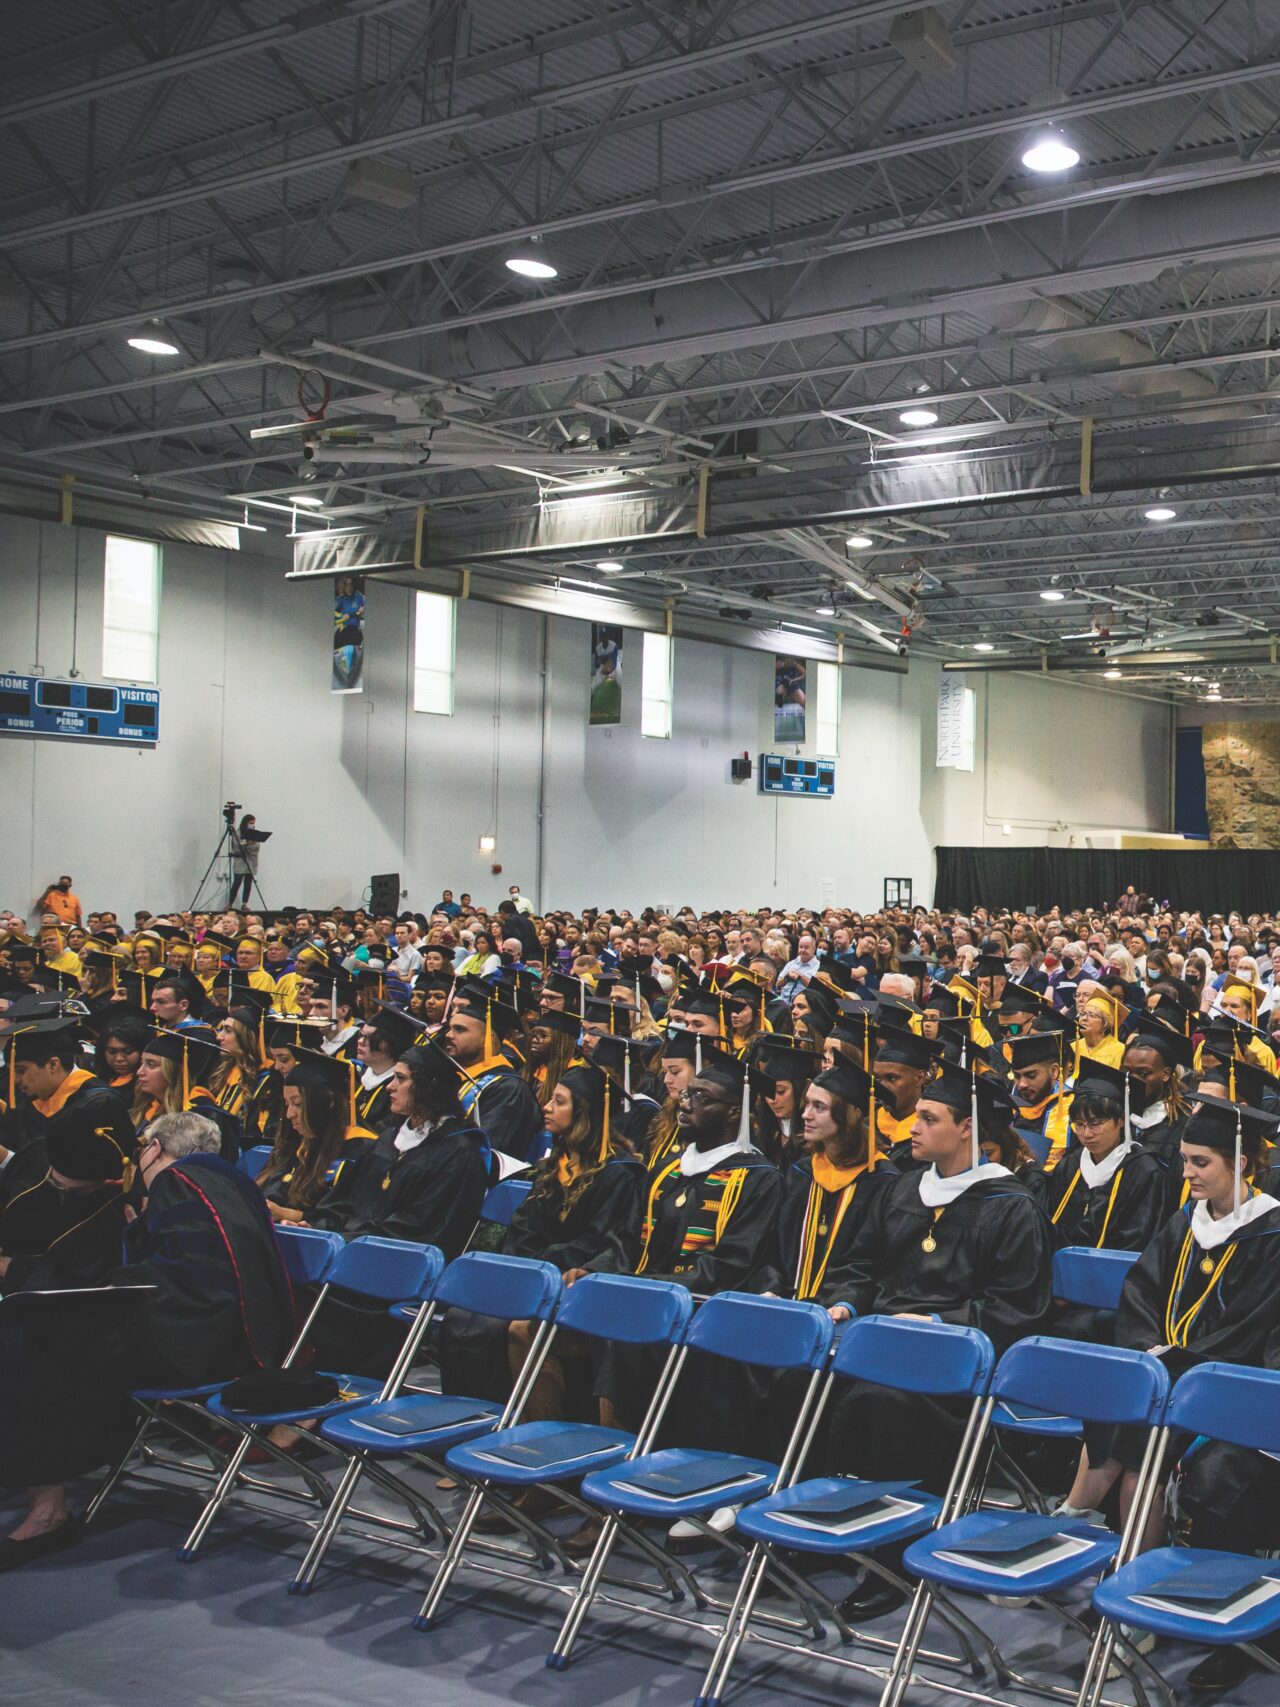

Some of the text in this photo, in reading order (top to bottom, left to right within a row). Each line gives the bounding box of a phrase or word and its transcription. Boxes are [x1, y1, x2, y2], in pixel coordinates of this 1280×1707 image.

[0, 677, 29, 690] HOME
[121, 690, 158, 703] VISITOR
[940, 678, 950, 710] PARK
[7, 718, 34, 728] BONUS
[56, 717, 84, 727] PERIOD
[118, 728, 143, 736] BONUS
